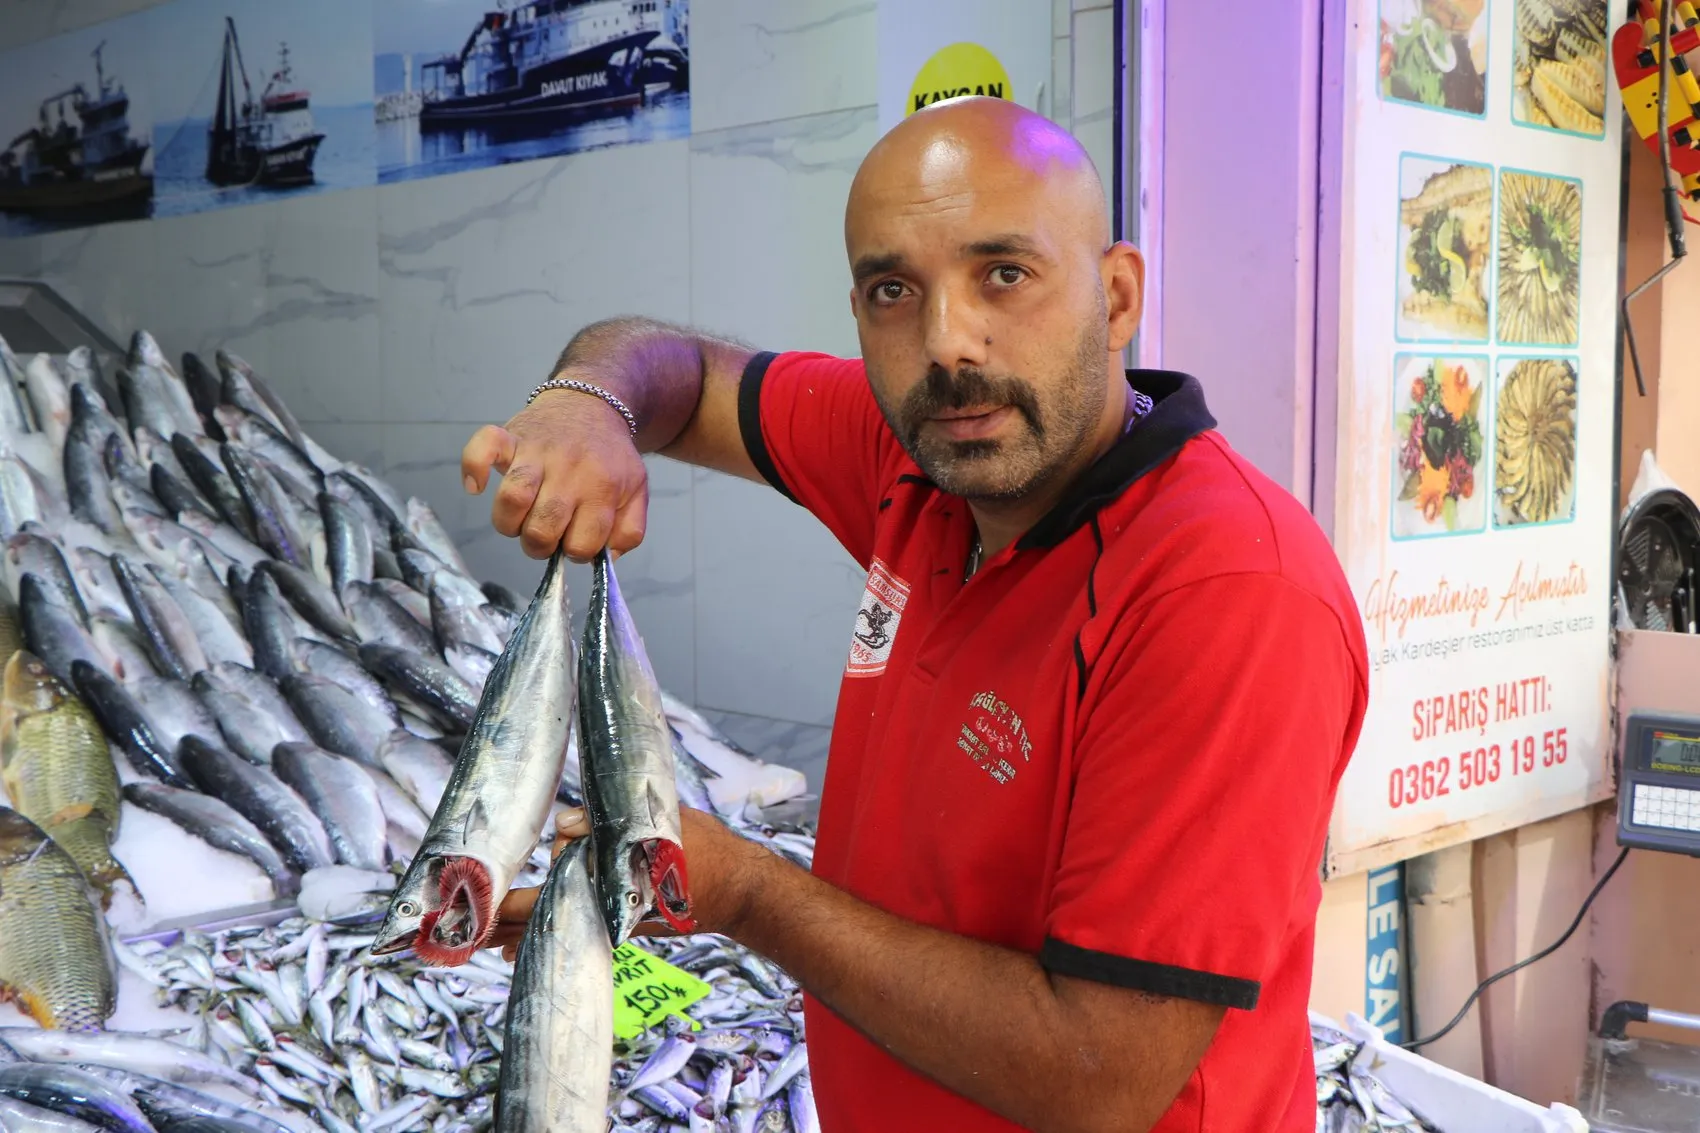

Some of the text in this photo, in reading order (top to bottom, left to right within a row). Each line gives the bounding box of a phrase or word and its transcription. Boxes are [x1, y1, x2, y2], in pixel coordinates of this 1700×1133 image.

[541, 71, 608, 97] DAVUT KIYAK
[1364, 569, 1489, 642] Hizmetinize
[1402, 636, 1464, 660] Kardeşler
[1467, 624, 1543, 649] restoranımız
[1545, 618, 1564, 636] üst
[1566, 615, 1595, 633] katta
[1495, 675, 1552, 722] HATTI:
[1389, 727, 1568, 809] 0362 503 19 55
[1369, 866, 1399, 940] LE
